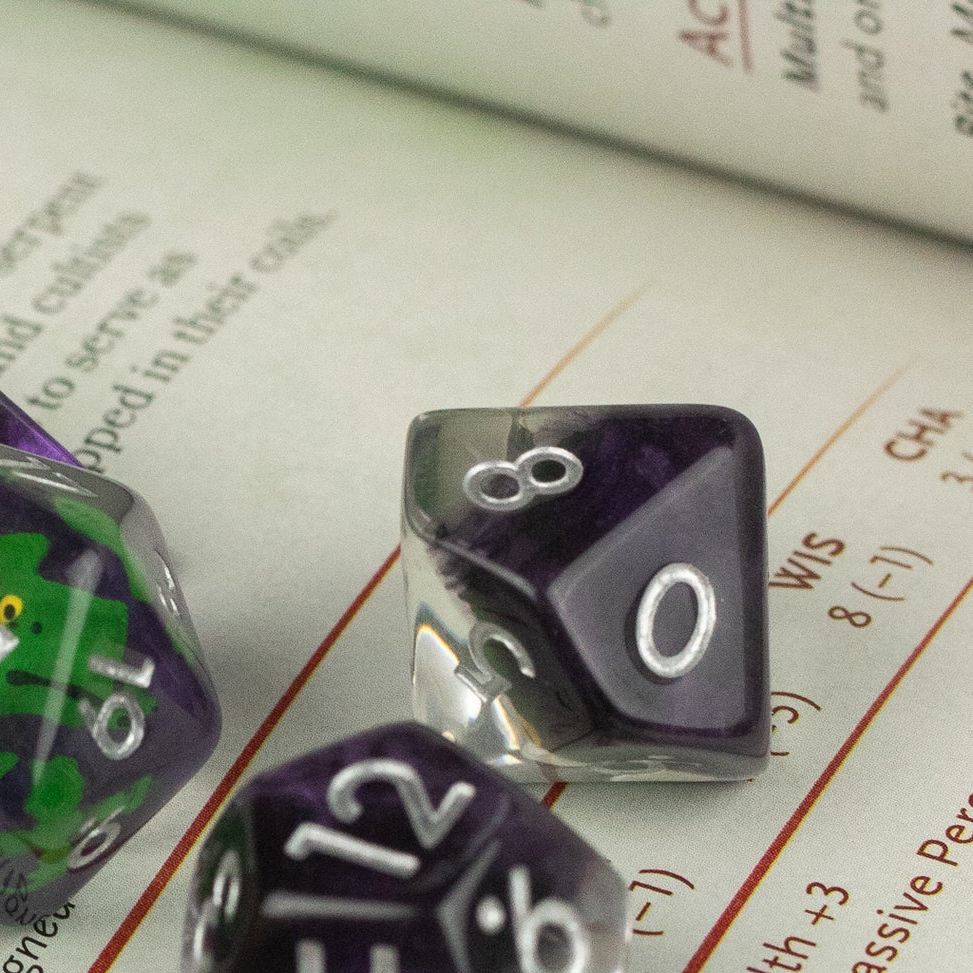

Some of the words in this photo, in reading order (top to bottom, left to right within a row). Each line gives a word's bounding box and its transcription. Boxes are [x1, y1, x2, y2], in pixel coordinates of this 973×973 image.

[29, 376, 76, 412] to
[65, 288, 161, 372] serve
[131, 348, 192, 384] in
[172, 273, 258, 346] their
[883, 406, 964, 463] CHA
[463, 446, 584, 512] 8
[768, 531, 847, 591] WIS
[635, 562, 717, 679] 0
[827, 604, 873, 629] 8
[284, 757, 477, 878] 12
[804, 881, 850, 926] +3
